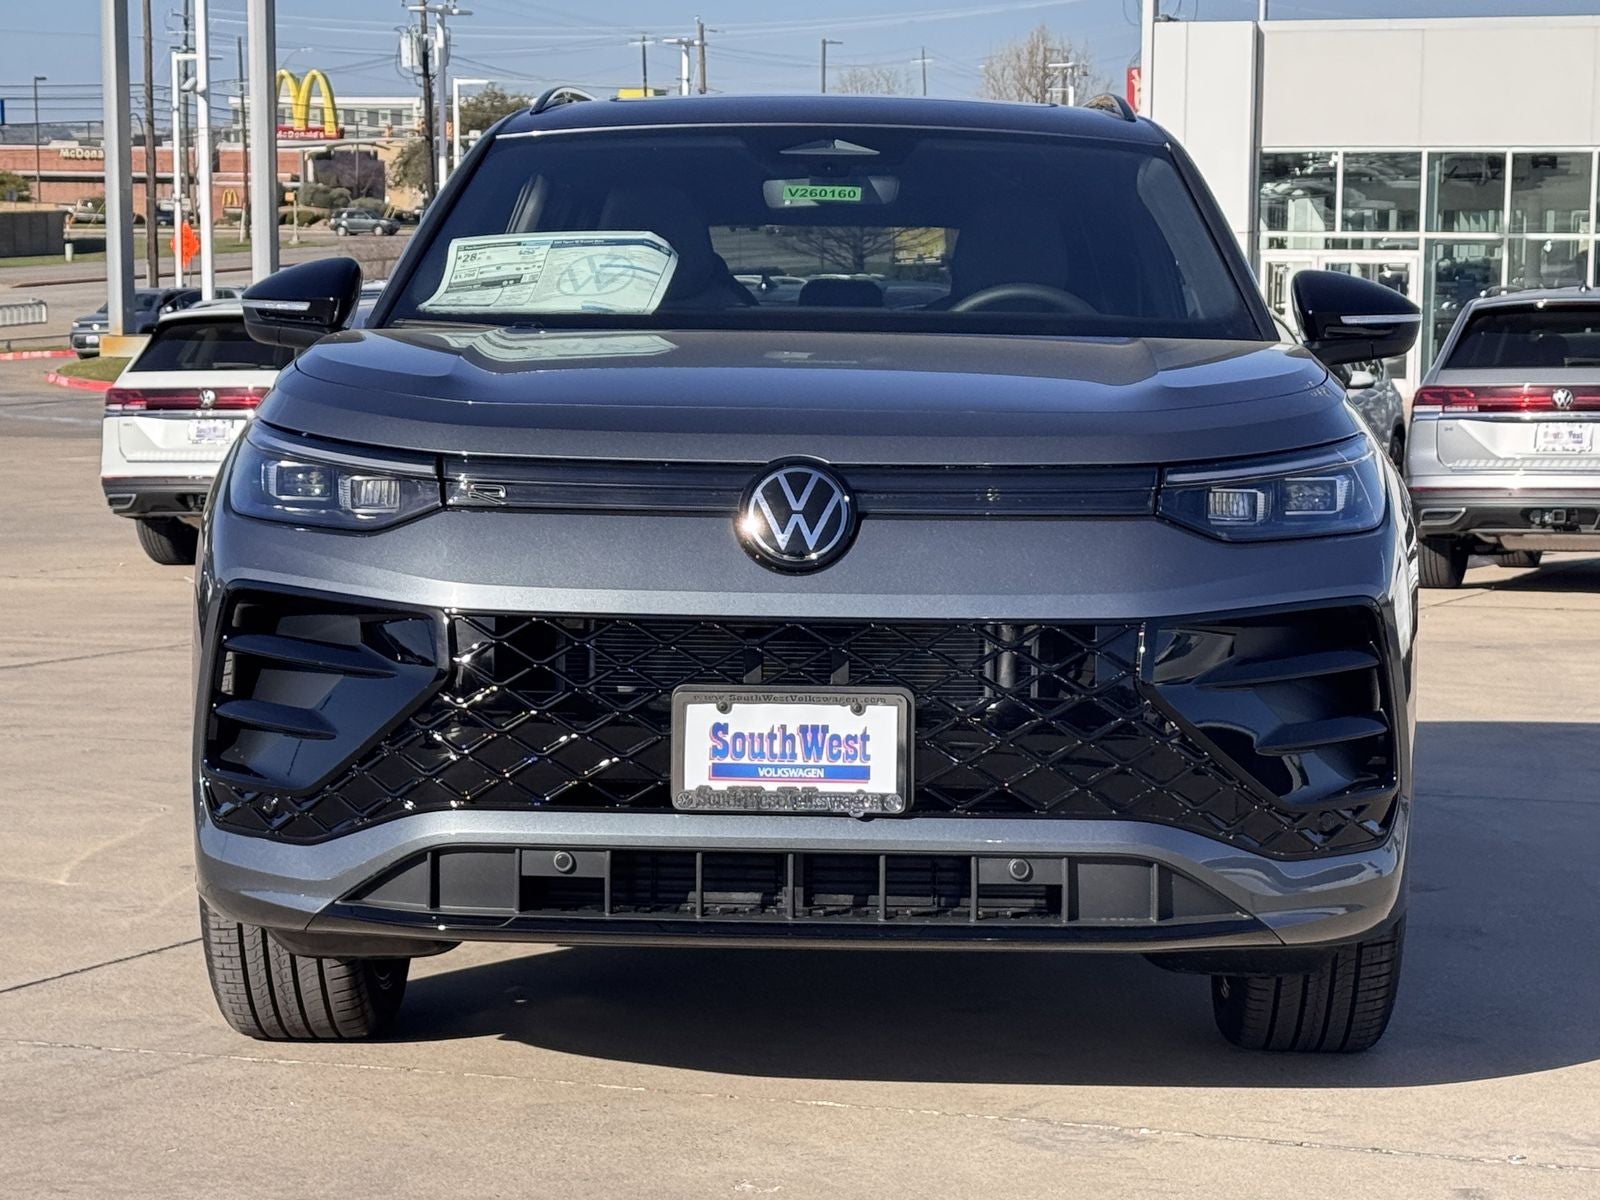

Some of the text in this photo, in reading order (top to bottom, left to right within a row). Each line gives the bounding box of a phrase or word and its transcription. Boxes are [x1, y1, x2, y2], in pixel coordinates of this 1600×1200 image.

[788, 187, 857, 199] V260160
[462, 253, 478, 263] 28
[709, 721, 871, 763] SouthWest
[758, 766, 825, 778] VOLKSWAGEN
